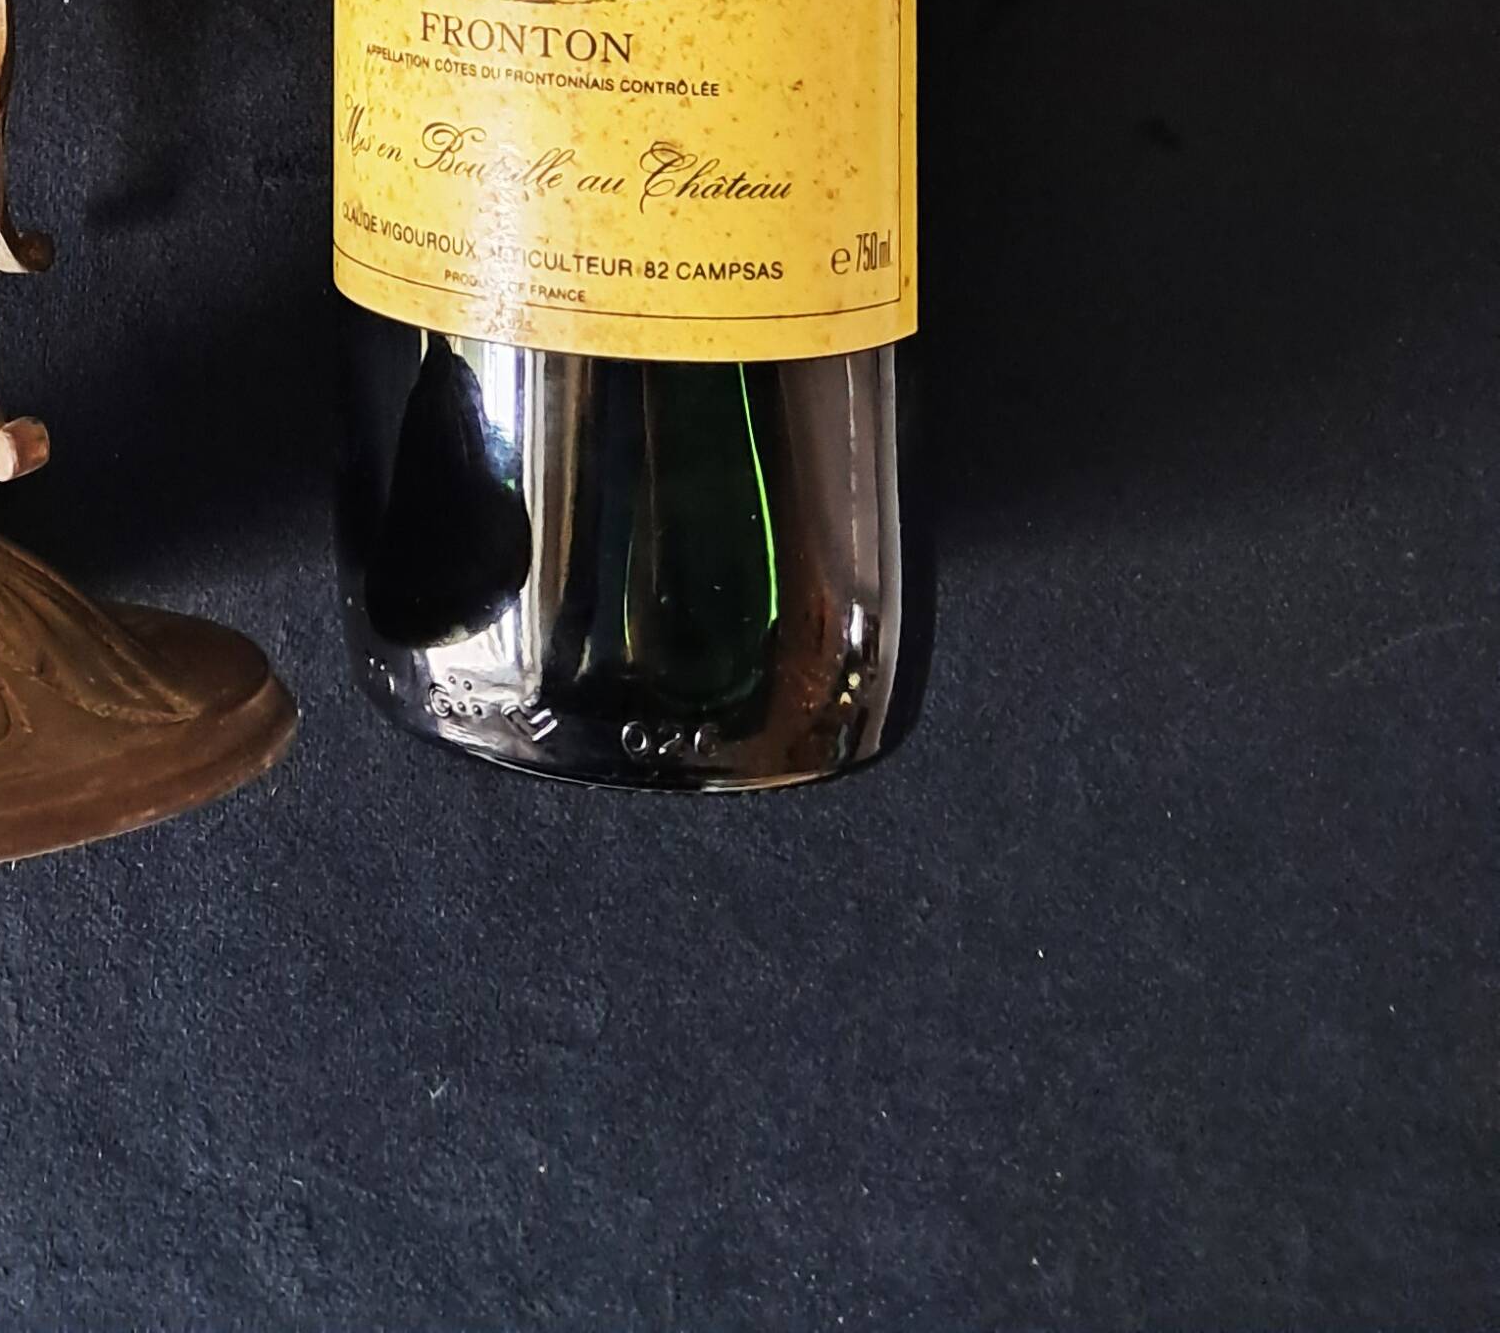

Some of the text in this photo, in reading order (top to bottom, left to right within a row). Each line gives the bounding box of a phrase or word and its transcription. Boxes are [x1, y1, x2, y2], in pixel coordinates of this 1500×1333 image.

[421, 11, 634, 64] FRONTON
[367, 44, 430, 69] APPELLATION
[435, 57, 476, 77] CÔTES
[481, 65, 501, 81] DU
[506, 68, 614, 92] FRONTONNAIS
[377, 143, 403, 162] en
[414, 122, 575, 189] Boulle
[577, 174, 625, 194] au
[639, 141, 793, 214] Château
[530, 283, 587, 303] FRANCE
[644, 260, 669, 280] 82
[676, 260, 784, 281] CAMPSAS
